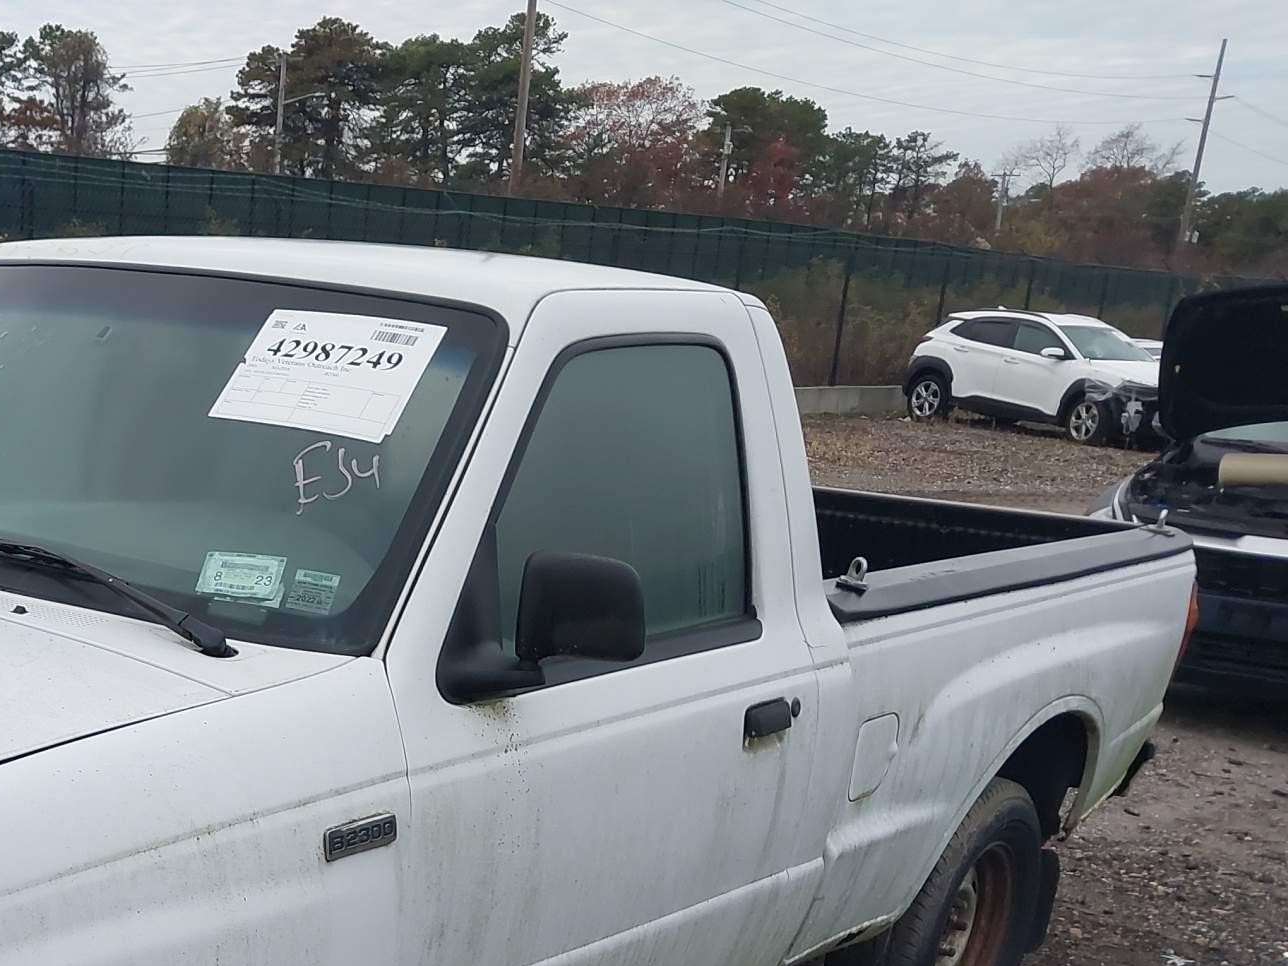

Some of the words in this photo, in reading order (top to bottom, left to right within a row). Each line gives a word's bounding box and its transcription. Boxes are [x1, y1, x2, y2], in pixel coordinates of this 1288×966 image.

[267, 338, 403, 370] 42987249
[213, 570, 224, 582] 8
[254, 574, 274, 587] 23
[330, 821, 394, 853] B2300
